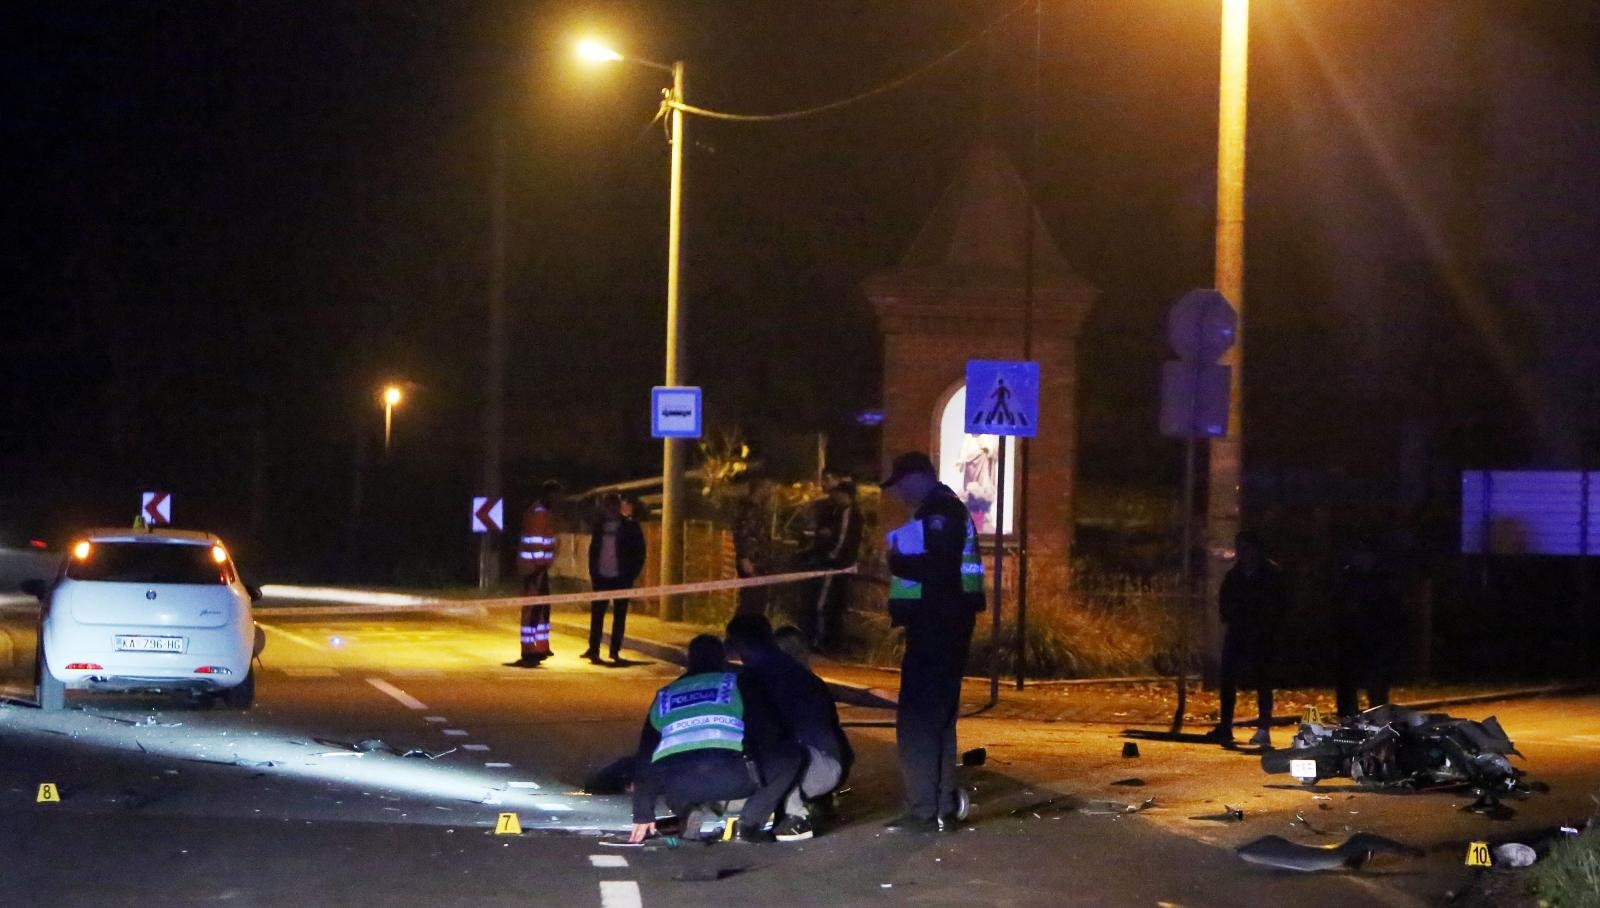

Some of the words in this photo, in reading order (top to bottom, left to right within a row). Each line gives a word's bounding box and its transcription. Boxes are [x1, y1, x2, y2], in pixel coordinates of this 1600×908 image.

[122, 639, 135, 648] KA
[671, 689, 715, 705] POLICIJA
[676, 716, 710, 730] POLICIJA
[43, 784, 52, 800] 8
[502, 814, 511, 831] 7
[1473, 846, 1488, 864] 10
